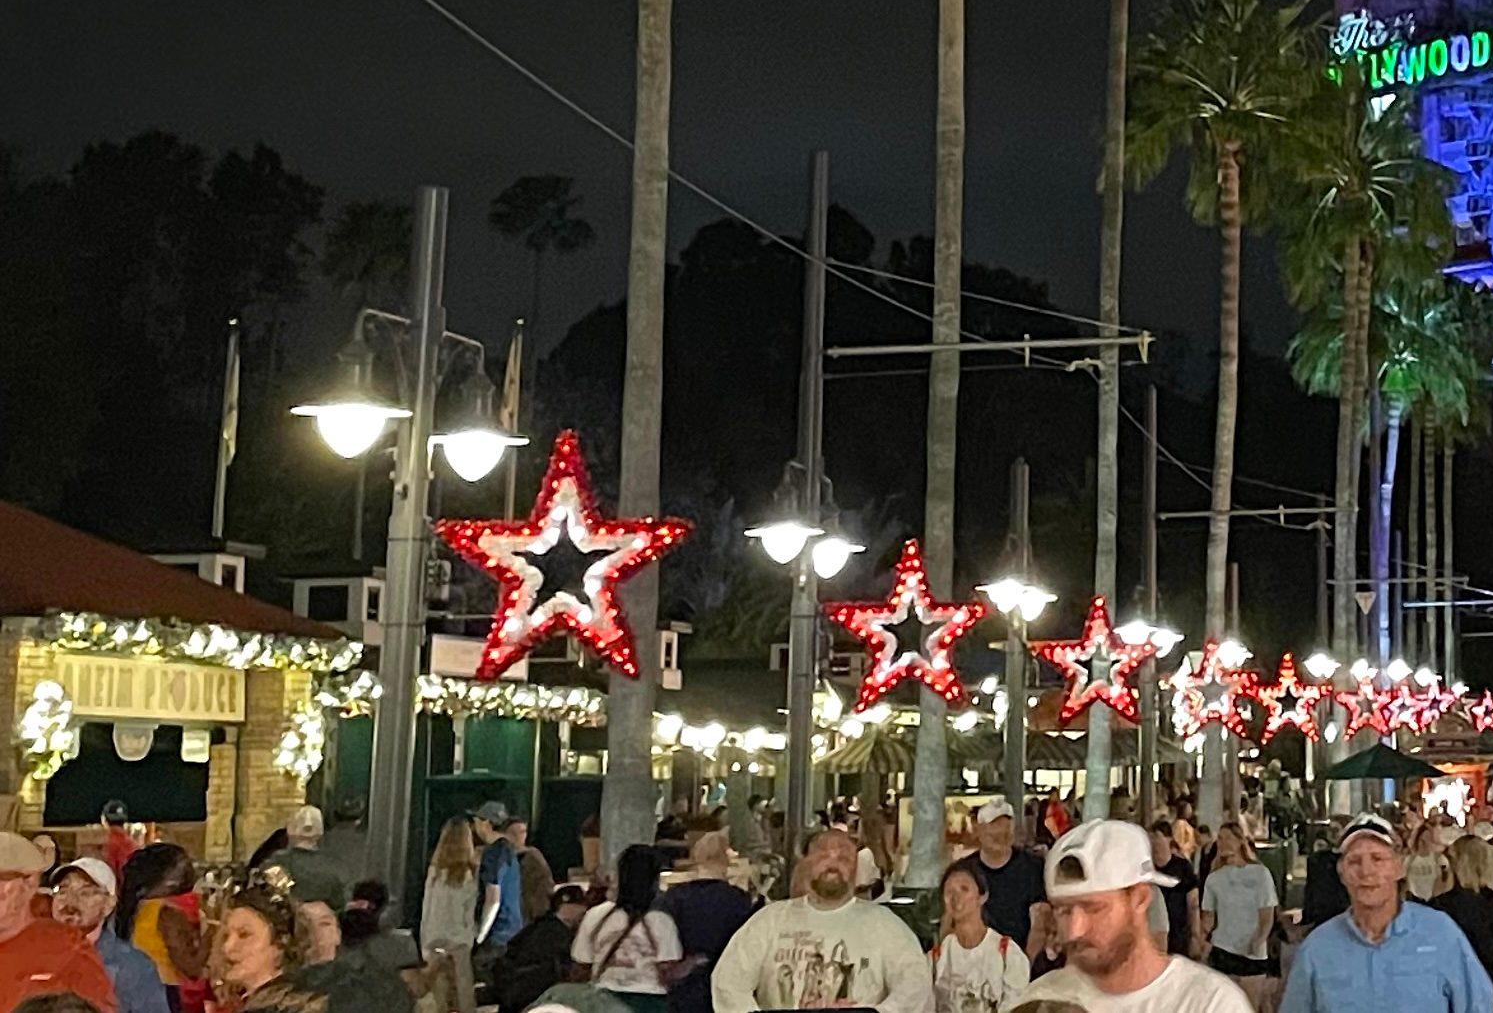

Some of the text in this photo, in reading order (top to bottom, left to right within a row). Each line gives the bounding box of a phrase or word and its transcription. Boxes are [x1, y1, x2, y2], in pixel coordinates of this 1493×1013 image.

[1333, 9, 1389, 55] The
[1328, 31, 1490, 89] LYWOOD
[144, 668, 237, 714] PRODUCE
